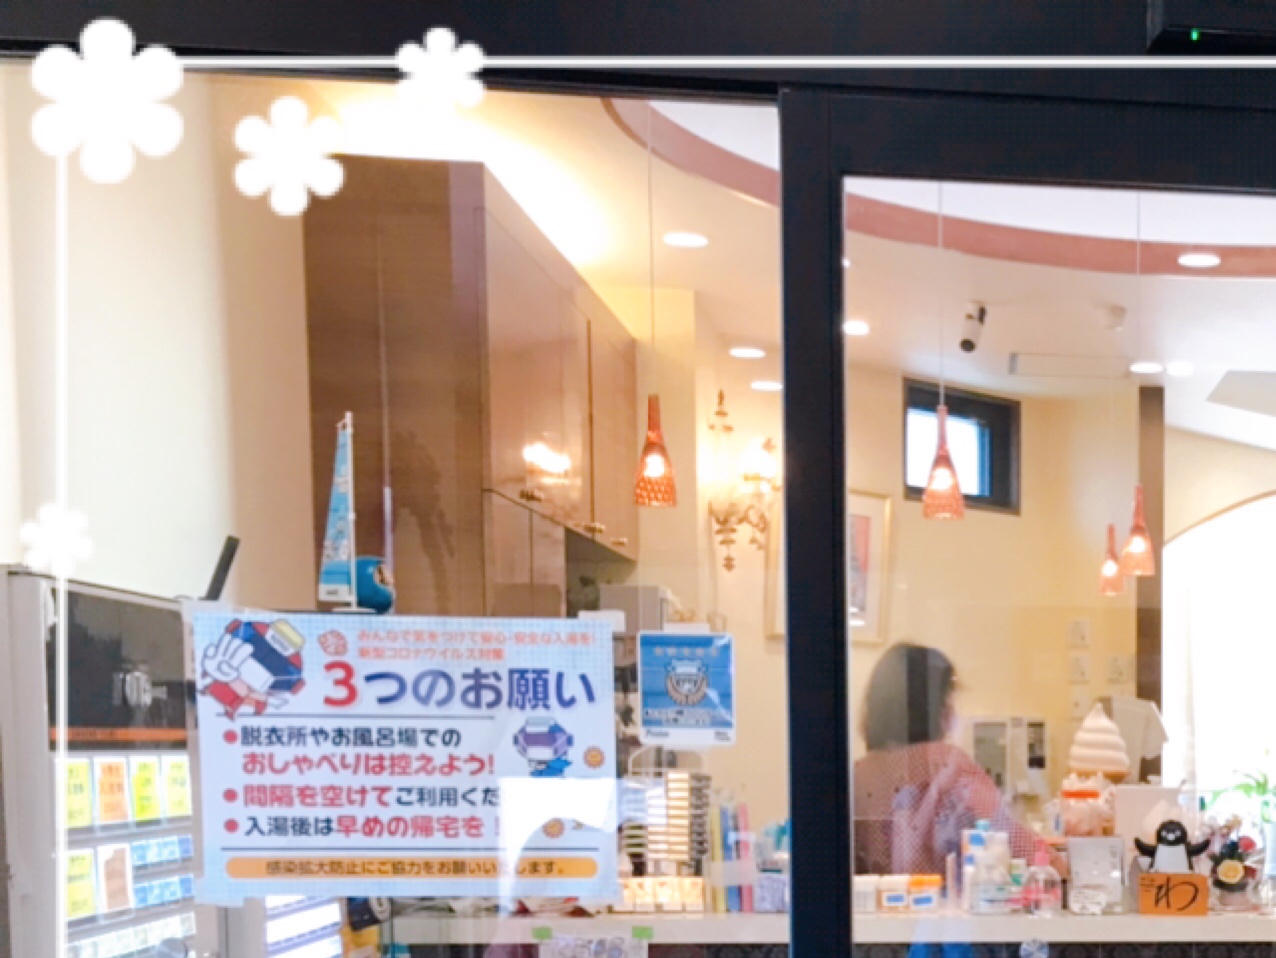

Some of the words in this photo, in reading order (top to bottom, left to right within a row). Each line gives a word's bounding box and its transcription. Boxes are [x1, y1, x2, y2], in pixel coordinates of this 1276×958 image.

[323, 661, 597, 711] 3つのお願い
[239, 725, 462, 748] 脱衣所やお風呂場での
[242, 752, 495, 776] おしゃべりは控えよう!
[264, 860, 566, 875] 感染拡大防止にご協力をお願いいします。
